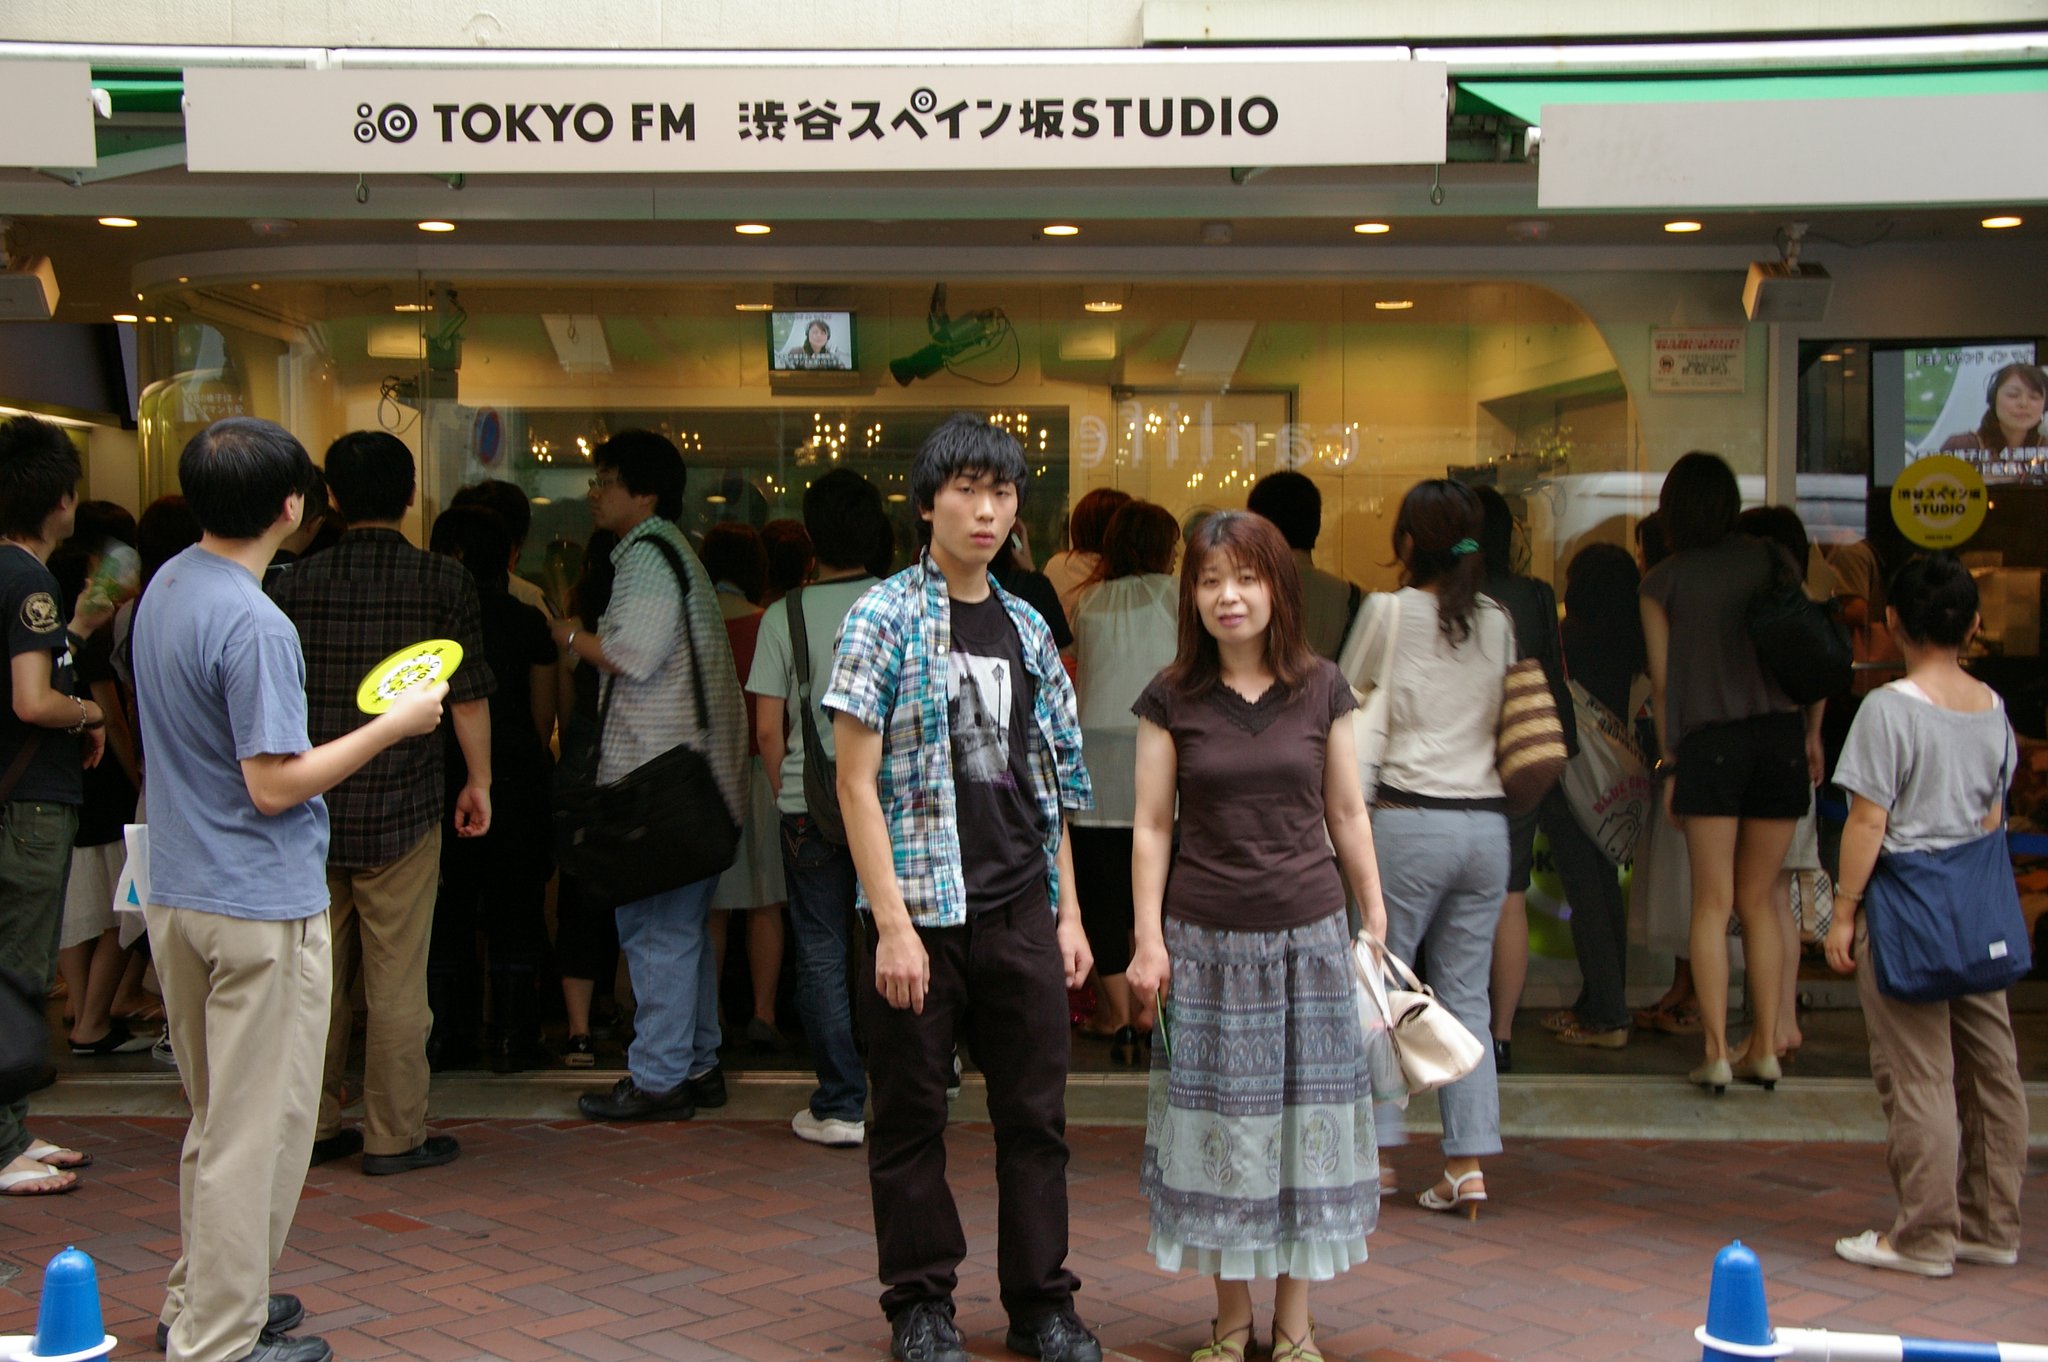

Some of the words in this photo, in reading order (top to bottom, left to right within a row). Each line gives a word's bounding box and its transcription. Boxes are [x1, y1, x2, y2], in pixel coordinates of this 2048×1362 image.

[432, 102, 614, 143] TOKYO
[631, 102, 695, 142] FM
[1912, 503, 1967, 517] STUDIO
